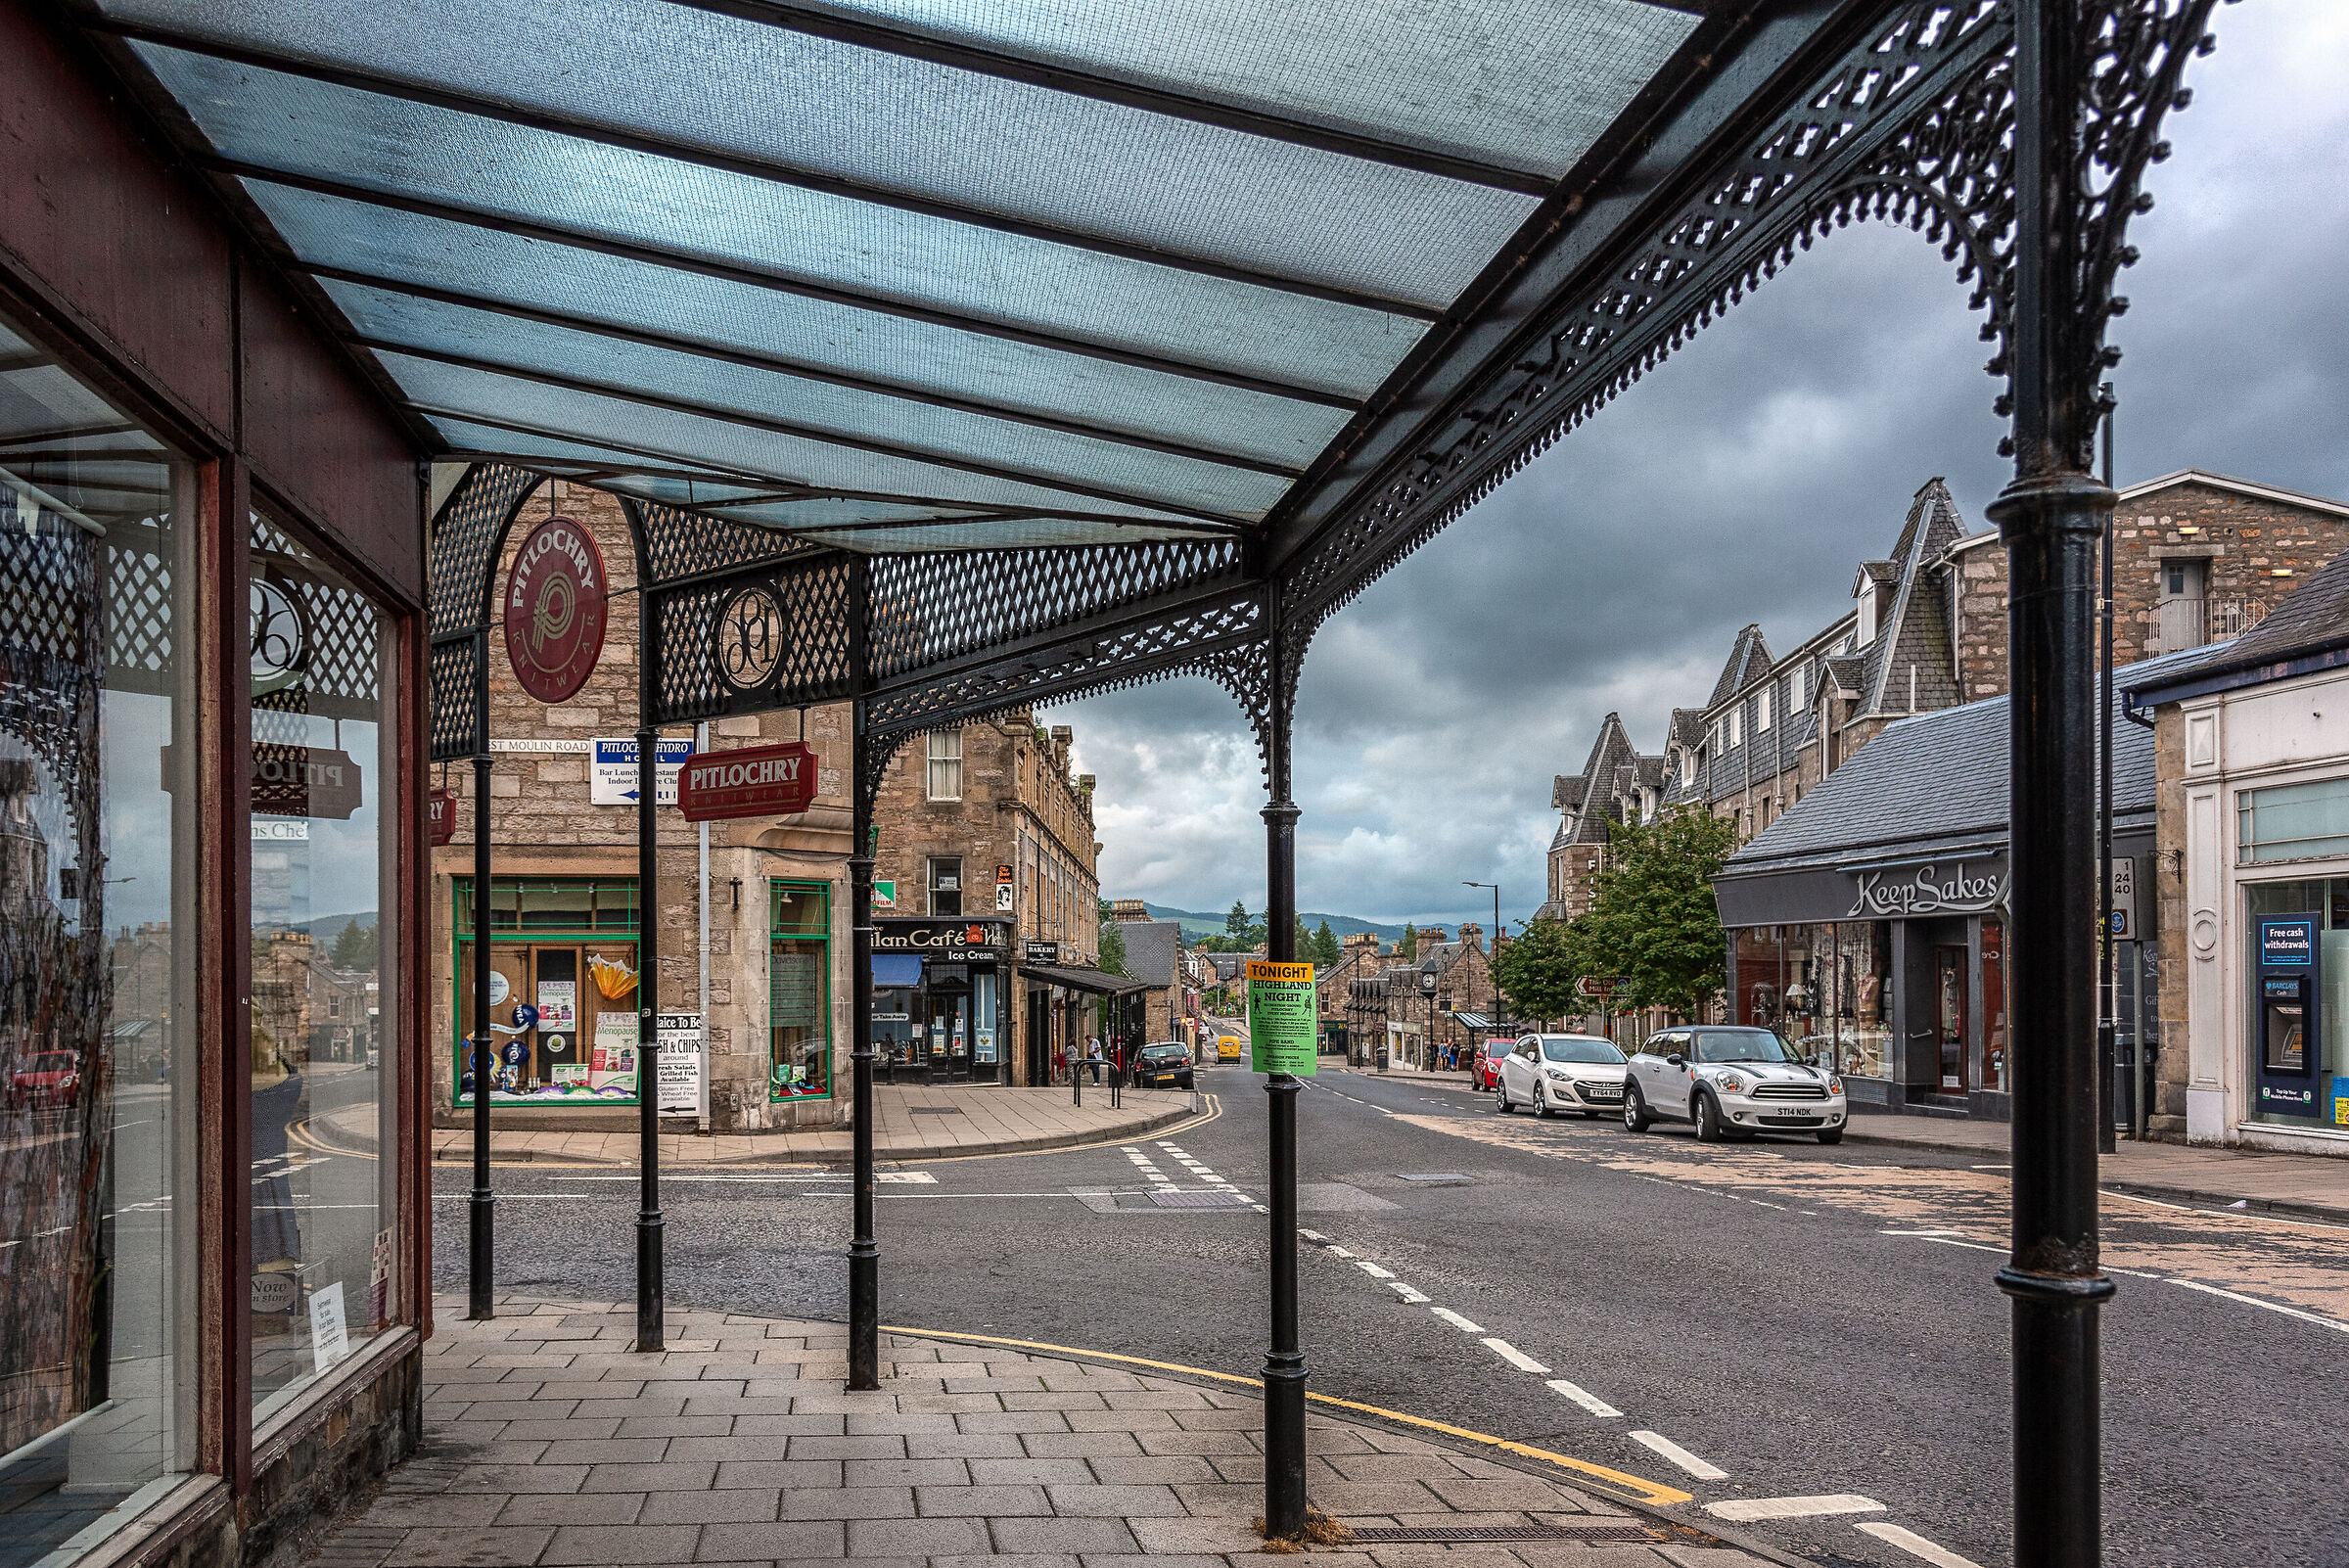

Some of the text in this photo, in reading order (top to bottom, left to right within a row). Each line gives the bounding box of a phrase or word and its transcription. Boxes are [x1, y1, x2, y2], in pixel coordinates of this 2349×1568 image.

[512, 529, 594, 608] PITLOCHRY
[513, 612, 595, 690] KNITWEAR
[489, 740, 588, 752] ST MOULIN ROAD
[601, 743, 689, 753] PITLOCH HYDRO
[689, 757, 802, 791] PITLOCHRY
[689, 786, 800, 807] KNITWEAR
[2124, 861, 2129, 870] 1
[2115, 873, 2131, 883] 24
[2115, 885, 2131, 895] 40
[909, 929, 966, 947] Café
[2270, 928, 2304, 938] Free cash
[2264, 940, 2309, 949] withdrawals
[948, 950, 994, 960] Ice Cream
[1251, 965, 1308, 979] TONIGHT
[1253, 980, 1313, 991] HIGHLAND
[1265, 992, 1302, 1002] NIGHT
[677, 1017, 688, 1028] To
[597, 1027, 638, 1037] Menopause
[670, 1040, 676, 1053] &
[677, 1038, 702, 1054] CHIPS
[252, 1280, 288, 1293] Now
